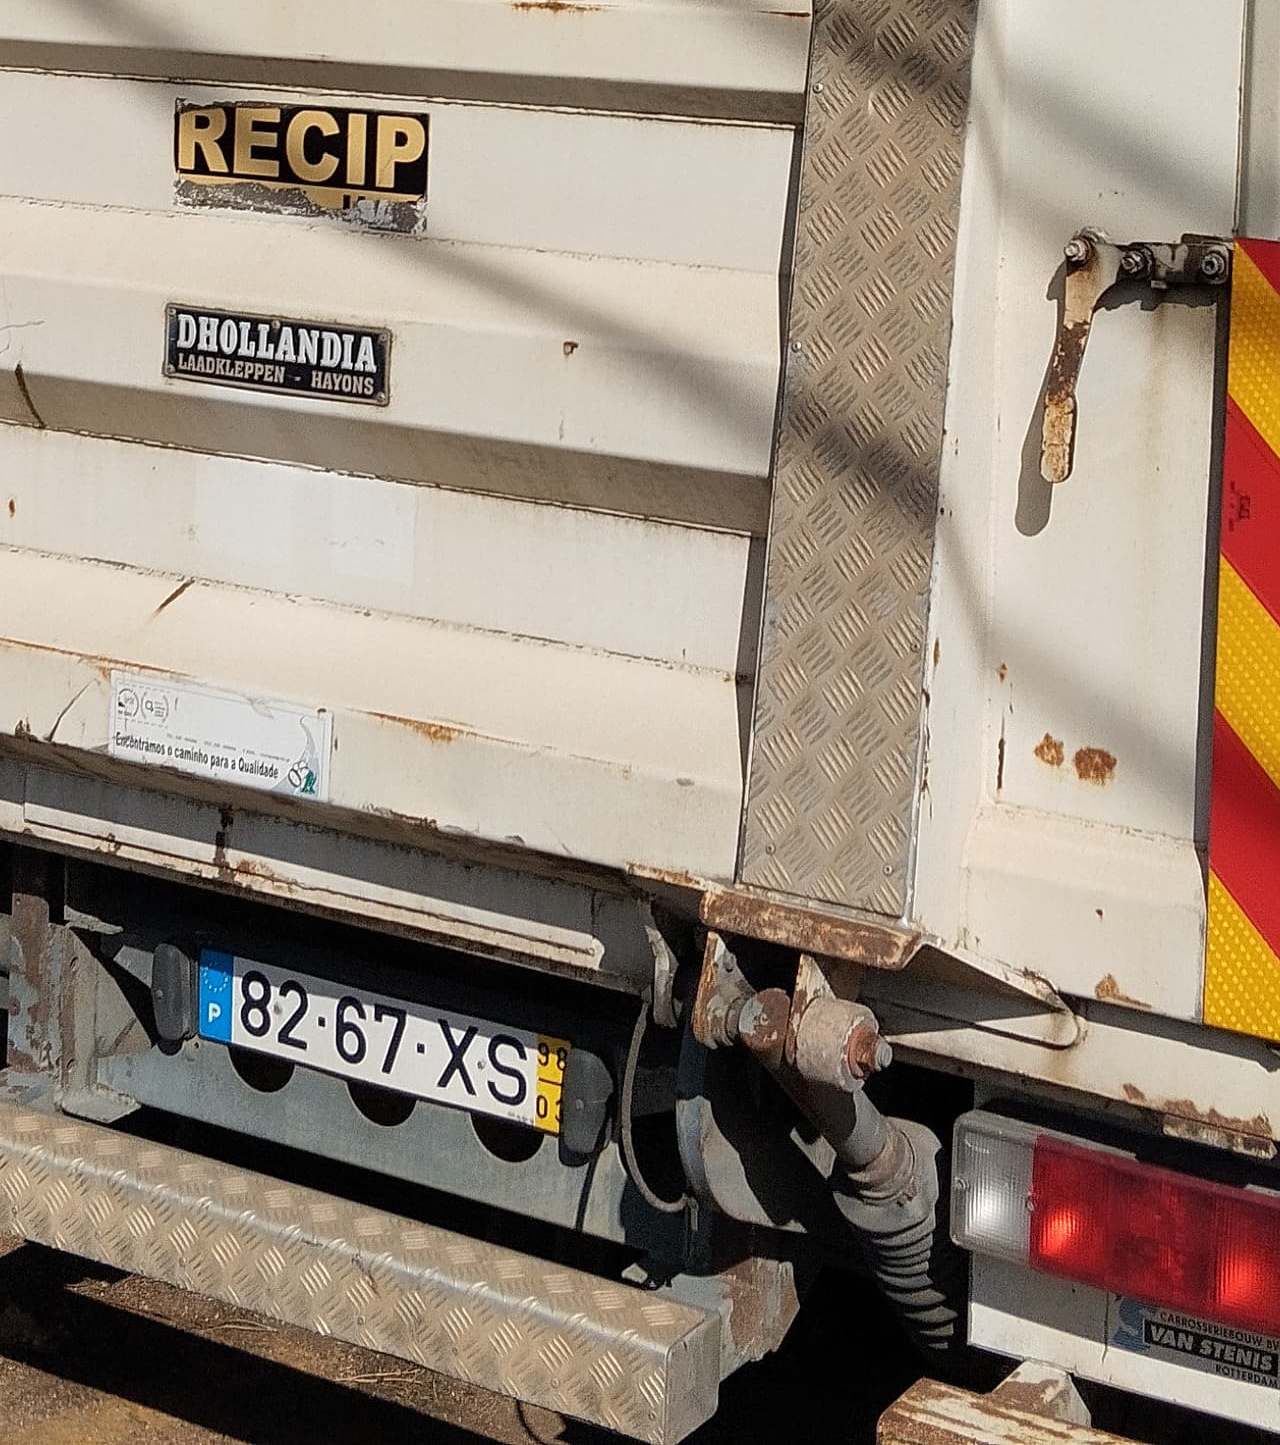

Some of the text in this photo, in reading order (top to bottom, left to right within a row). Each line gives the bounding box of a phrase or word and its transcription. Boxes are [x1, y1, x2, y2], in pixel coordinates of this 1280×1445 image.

[178, 107, 426, 188] RECIP
[176, 313, 377, 373] DHOLLANDIA
[177, 353, 286, 384] LAADKLEPPEN
[311, 370, 375, 395] HAYONS
[174, 747, 208, 765] caminho
[210, 754, 229, 769] para
[231, 759, 236, 770] a
[238, 757, 279, 779] Qualidade
[207, 1002, 222, 1023] P
[537, 1042, 568, 1071] 98
[1150, 1324, 1273, 1371] VAN STENIS
[1215, 1363, 1279, 1389] ROTTERDAM
